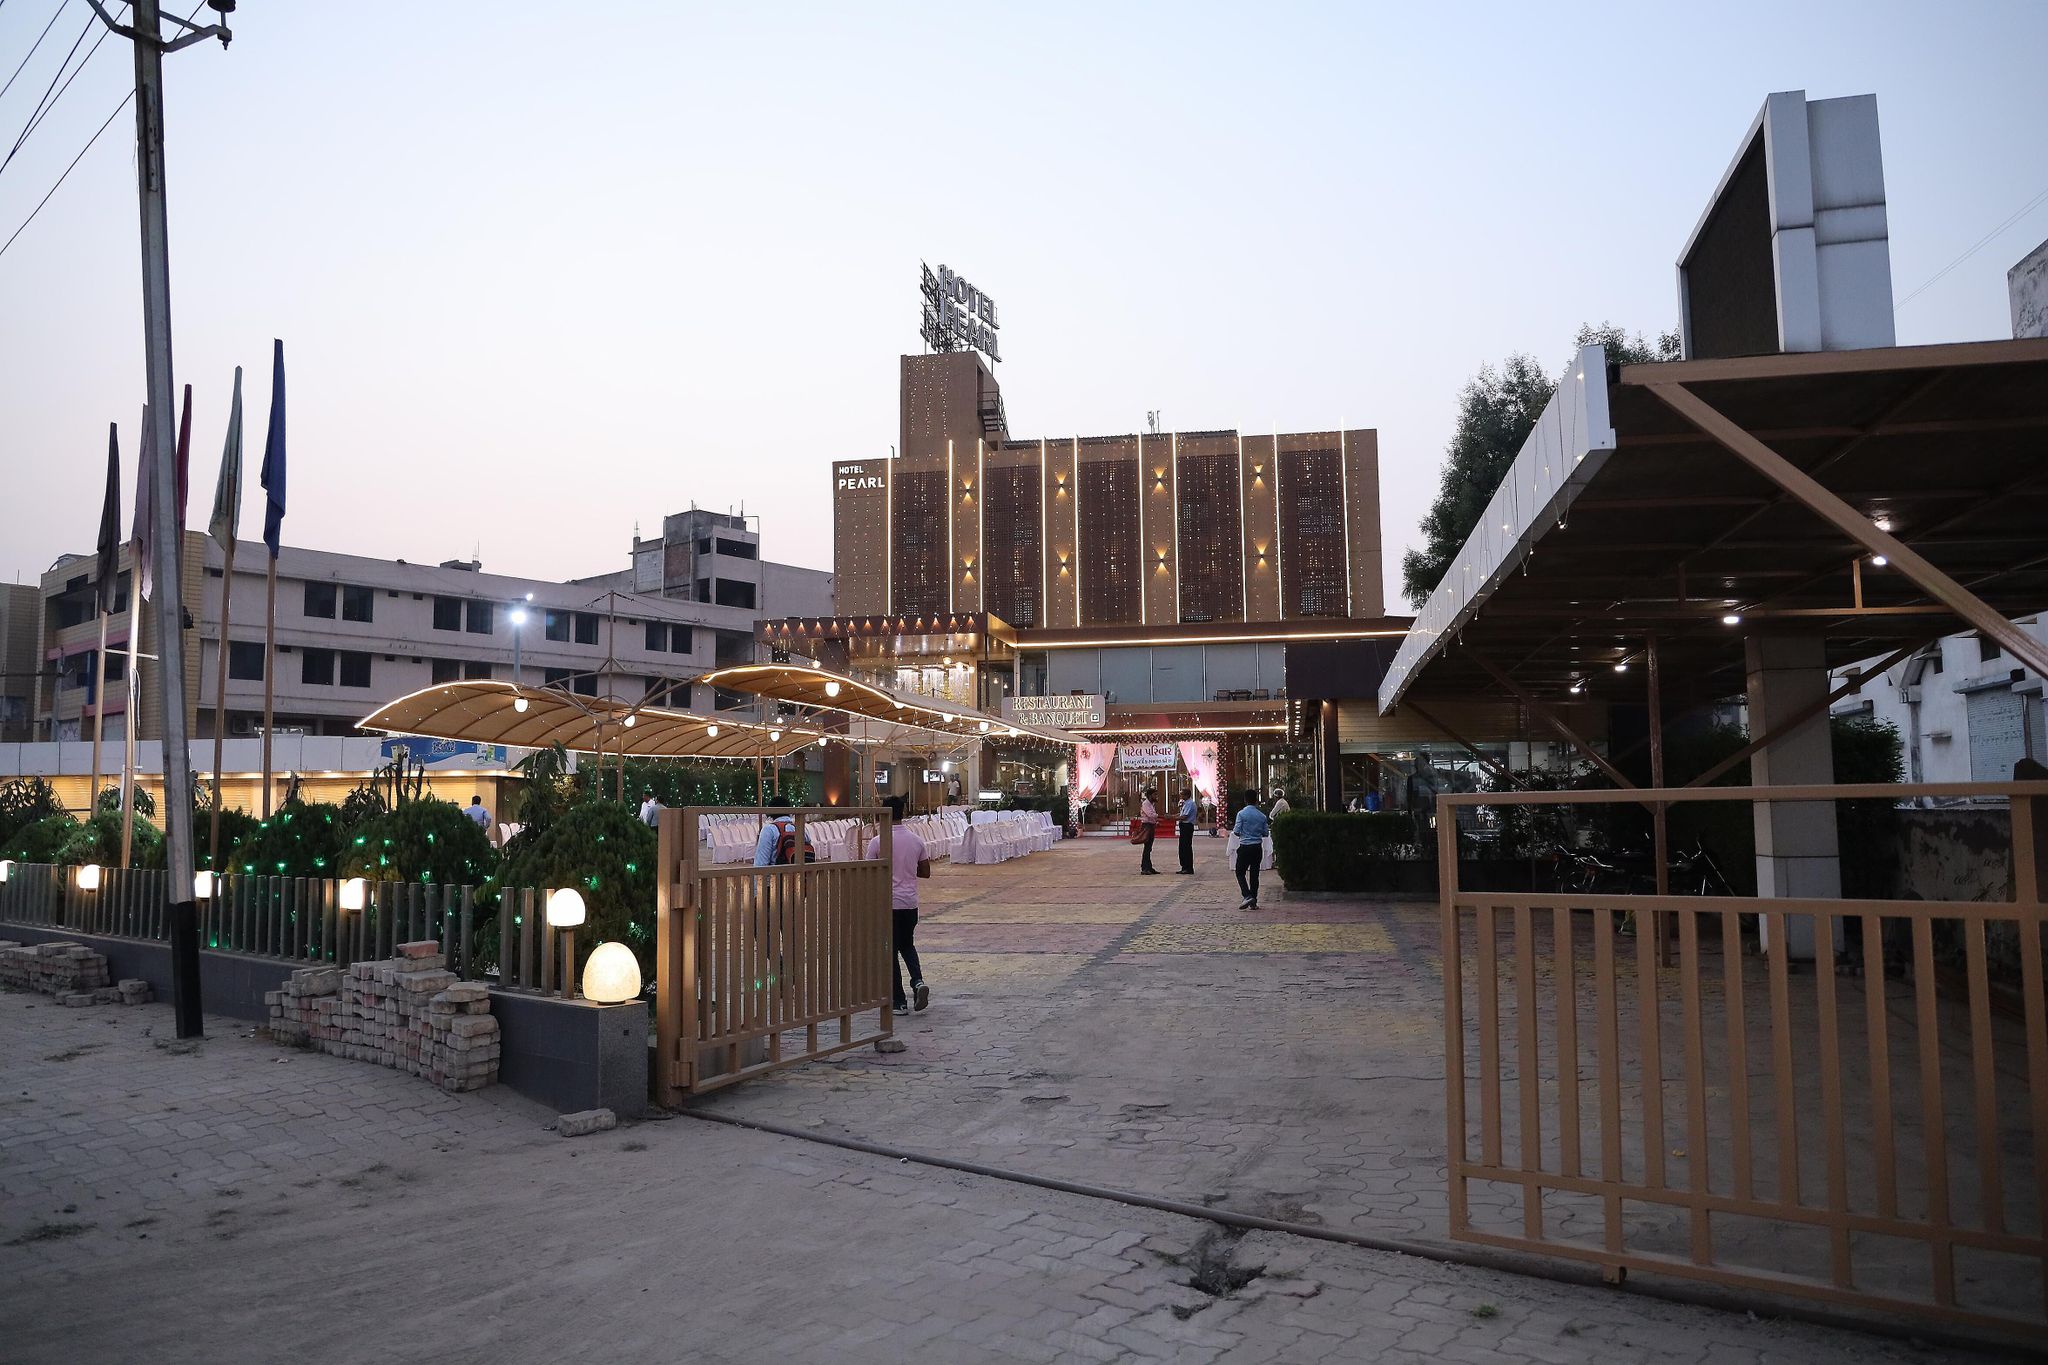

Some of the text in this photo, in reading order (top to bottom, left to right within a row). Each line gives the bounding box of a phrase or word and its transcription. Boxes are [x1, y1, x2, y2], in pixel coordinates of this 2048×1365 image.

[938, 264, 1000, 329] HOTEL
[839, 465, 864, 474] HOTEL
[838, 477, 885, 490] PEARL
[1012, 695, 1094, 710] RESTAURANT
[1018, 711, 1089, 728] & BANQUET
[1124, 744, 1172, 757] પટેલ પરિવાર
